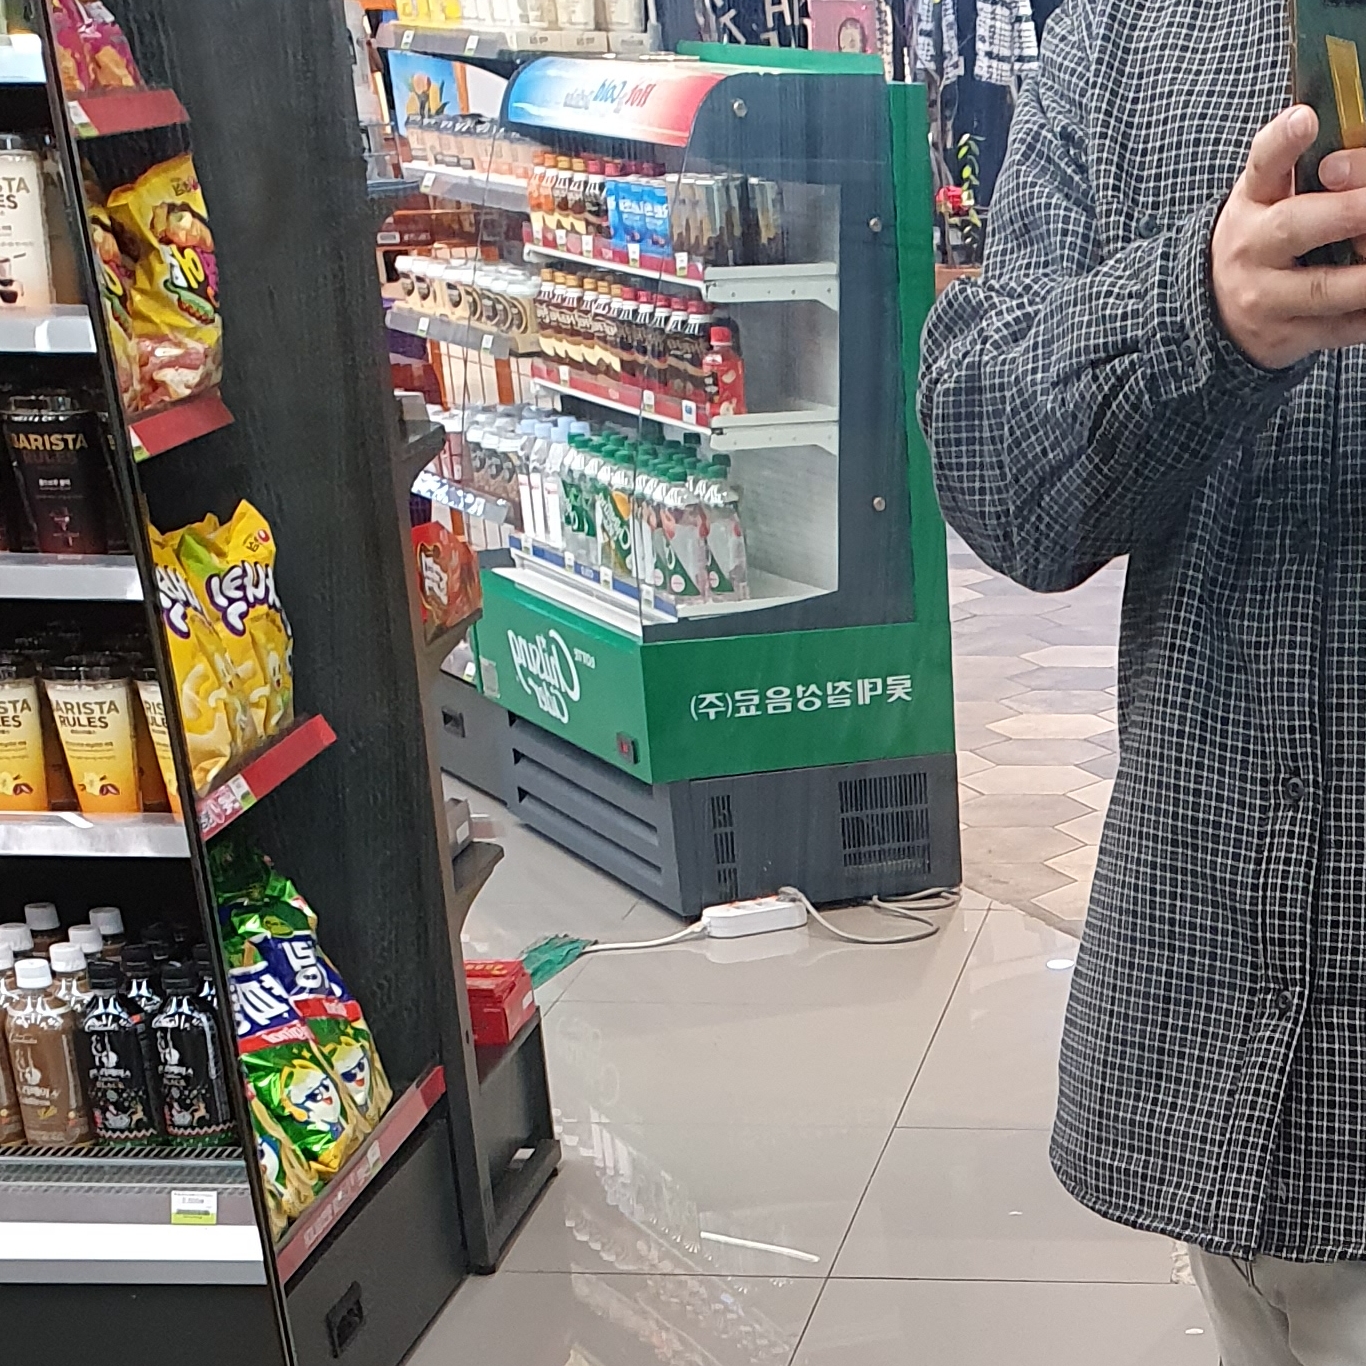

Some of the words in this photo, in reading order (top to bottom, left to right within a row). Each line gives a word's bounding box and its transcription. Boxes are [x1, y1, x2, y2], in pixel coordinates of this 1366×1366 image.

[0, 176, 31, 194] TA
[53, 700, 120, 715] ARISTA
[60, 715, 109, 729] RULES
